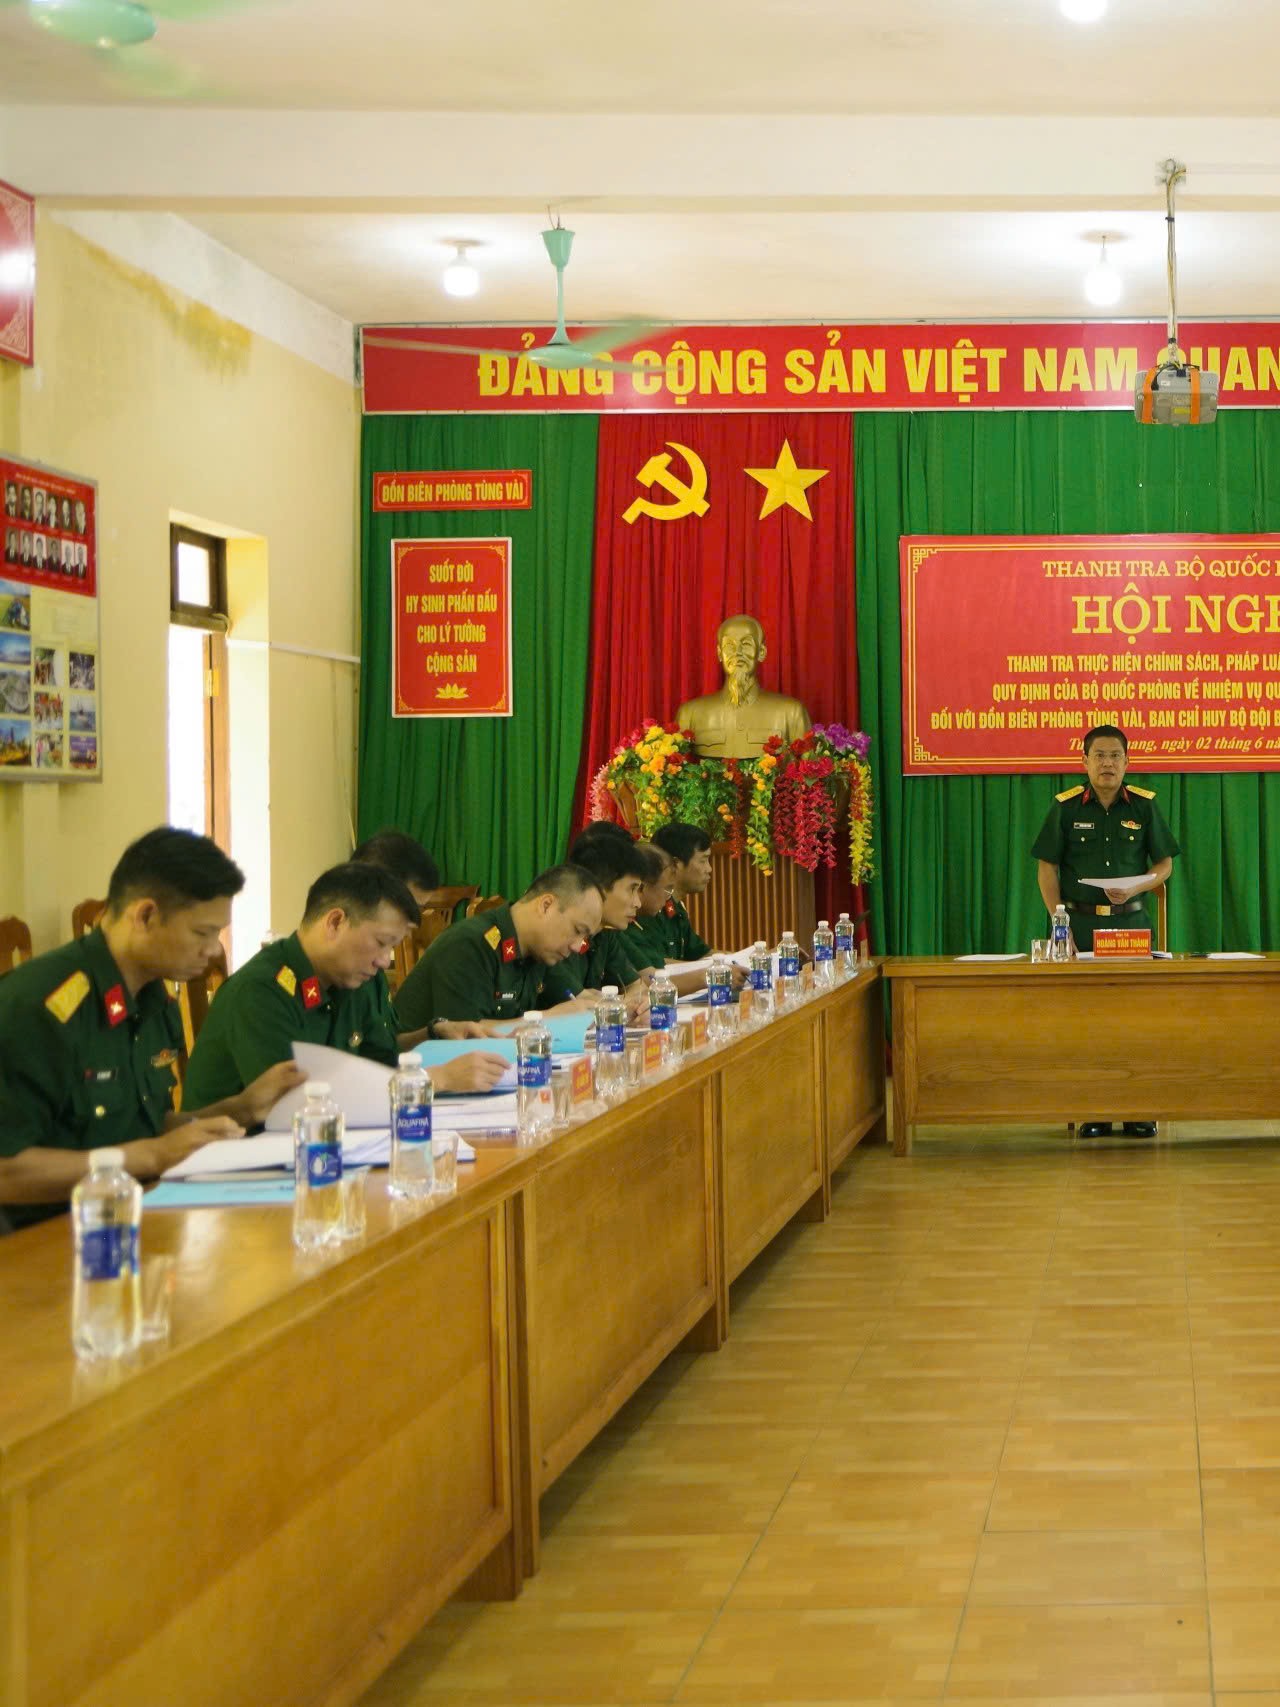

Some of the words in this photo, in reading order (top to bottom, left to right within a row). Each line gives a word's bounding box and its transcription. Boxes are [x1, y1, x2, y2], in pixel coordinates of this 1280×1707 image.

[478, 332, 614, 396] ĐẢNG
[632, 341, 767, 405] CỘNG
[784, 330, 886, 394] SẢN
[903, 339, 1007, 403] VIỆT
[1024, 347, 1138, 392] NAM
[408, 481, 432, 502] BIÊN
[436, 480, 472, 502] PHÒNG
[475, 479, 503, 501] TÙNG
[429, 558, 455, 583] SUỐT
[1042, 560, 1122, 577] THANH
[1126, 560, 1171, 577] TRA
[1175, 555, 1205, 581] BỘ
[1209, 552, 1271, 578] QUỐC
[406, 594, 419, 613] HY
[421, 594, 445, 613] SINH
[447, 588, 475, 612] PHẤN
[477, 588, 498, 612] ĐẤU
[1072, 582, 1171, 645] HỘI
[417, 625, 437, 643] CHO
[440, 621, 451, 643] LÝ
[453, 618, 486, 642] TƯỞNG
[426, 651, 454, 676] CỘNG
[456, 648, 477, 672] SẢN
[1007, 655, 1048, 673] THANH
[1051, 655, 1074, 672] TRA
[1077, 653, 1109, 675] THỰC
[1112, 652, 1141, 675] HIỆN
[1145, 651, 1183, 671] CHÍNH
[1186, 651, 1223, 673] SÁCH,
[1226, 650, 1260, 671] PHÁP
[993, 683, 1017, 702] QUY
[1020, 683, 1050, 704] ĐỊNH
[1054, 678, 1079, 700] CỦA
[1082, 680, 1099, 703] BỘ
[1102, 677, 1135, 701] QUỐC
[1138, 678, 1181, 700] PHÒNG
[1184, 677, 1199, 699] VỀ
[1202, 679, 1243, 702] NHIỆM
[1246, 681, 1262, 702] VỤ
[931, 706, 952, 729] ĐỐI
[955, 708, 976, 729] VỚI
[979, 706, 1005, 729] ĐỒN
[1008, 708, 1037, 729] BIÊN
[1040, 707, 1083, 728] PHÒNG
[1086, 707, 1119, 728] TÙNG
[1122, 707, 1146, 730] VÀI,
[1149, 710, 1175, 727] BAN
[1178, 705, 1199, 727] CHỈ
[1202, 710, 1226, 727] HUY
[1230, 706, 1247, 731] BỘ
[1250, 706, 1270, 731] ĐỘI
[1161, 737, 1193, 752] ngày
[1195, 737, 1212, 750] 02
[1214, 736, 1251, 752] tháng
[1254, 736, 1264, 749] 6
